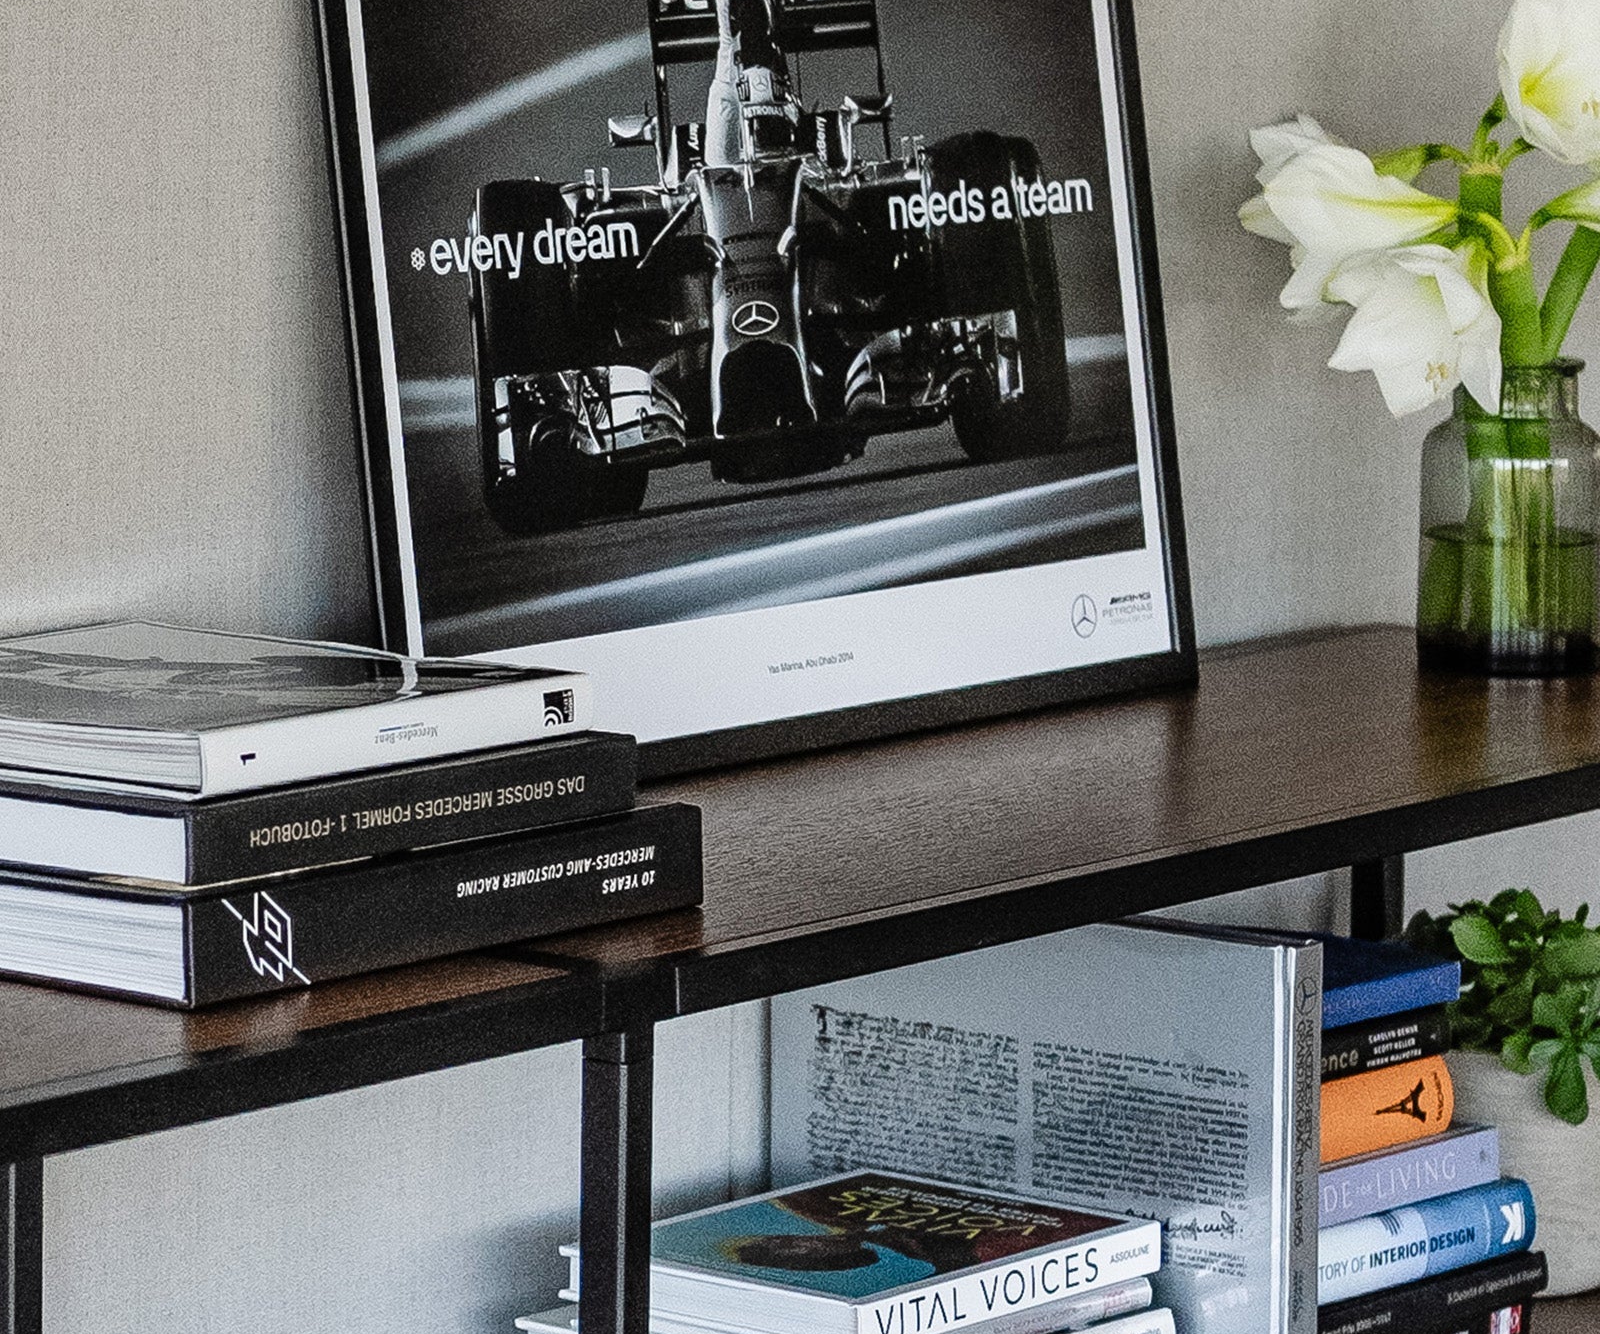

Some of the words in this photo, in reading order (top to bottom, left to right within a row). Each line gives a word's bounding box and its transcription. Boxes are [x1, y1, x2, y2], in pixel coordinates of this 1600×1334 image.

[888, 179, 985, 230] needs
[991, 186, 1012, 219] a
[1017, 176, 1093, 217] team
[430, 232, 524, 279] every
[534, 218, 639, 264] dream
[497, 781, 554, 807] GROSSE
[557, 775, 585, 795] DAS
[352, 805, 411, 830] FORMEL
[415, 790, 493, 820] MERCEDES
[340, 814, 348, 832] 1
[566, 845, 656, 877] MERCEDES-AMG
[457, 875, 500, 898] RACING
[503, 863, 564, 888] CUSTOMER
[602, 873, 639, 894] YEARS
[641, 870, 656, 886] 10
[1376, 1153, 1457, 1199] LIVING
[1351, 1255, 1366, 1273] OF
[1370, 1240, 1426, 1268] INTERIOR
[1429, 1227, 1475, 1253] DESIGN
[980, 1247, 1099, 1312] VOICES
